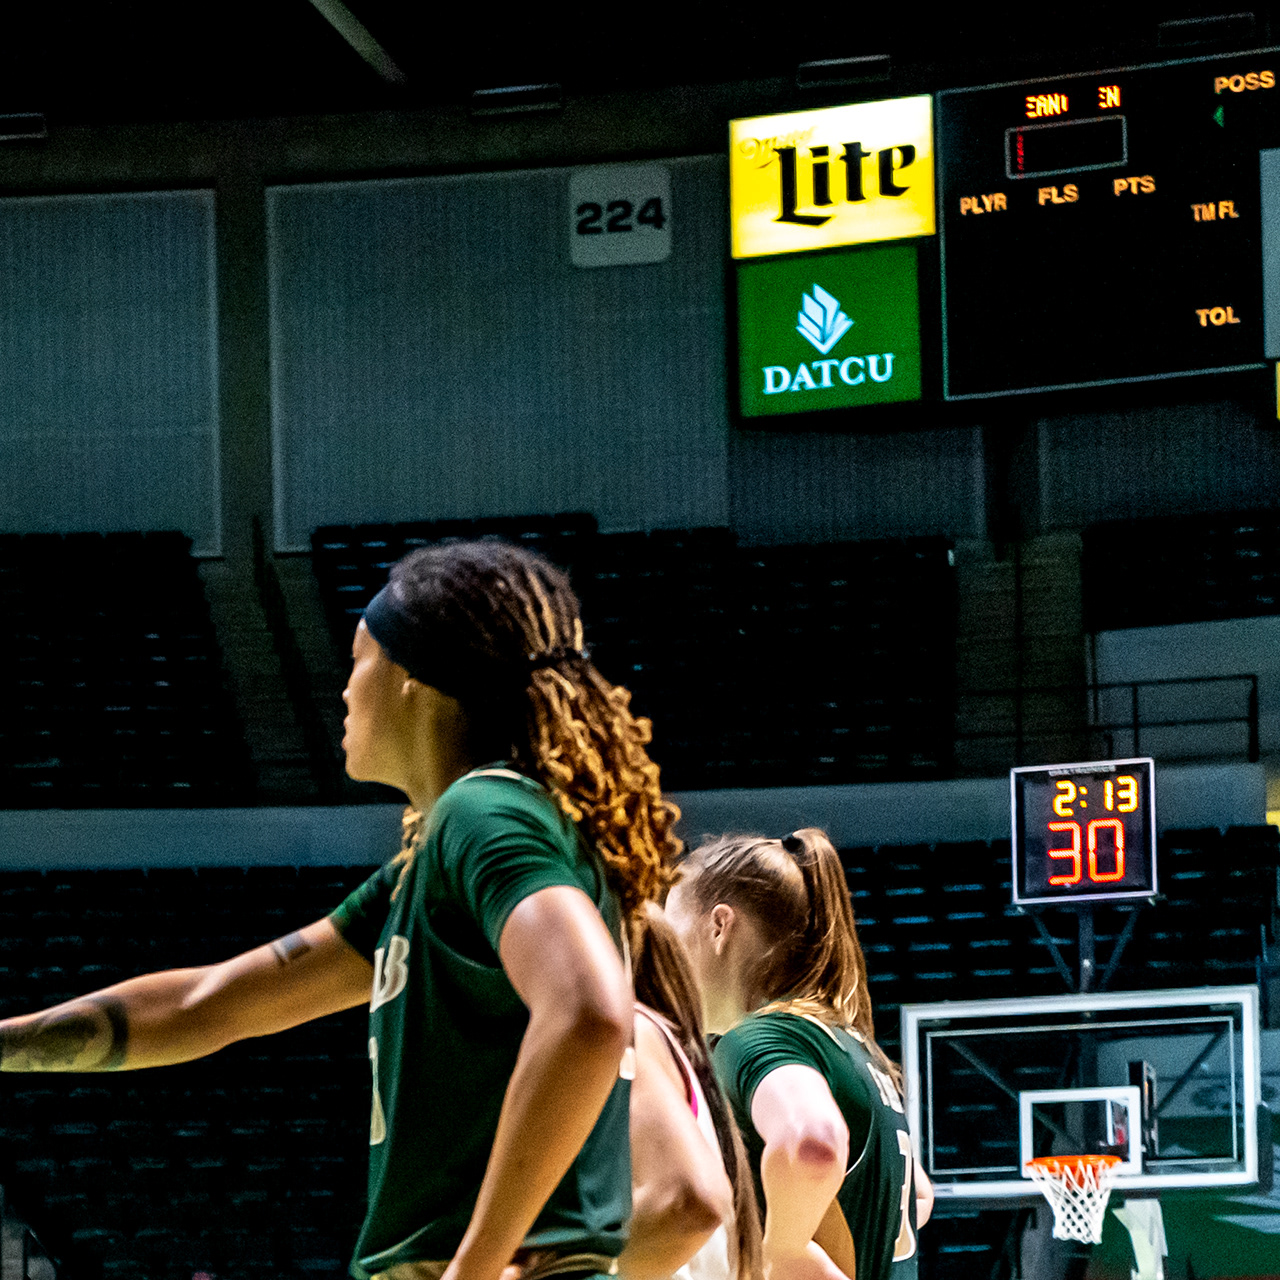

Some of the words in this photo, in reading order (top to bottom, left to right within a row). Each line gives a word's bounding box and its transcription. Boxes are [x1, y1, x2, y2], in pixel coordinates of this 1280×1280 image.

[1214, 69, 1276, 94] POSS
[772, 141, 916, 228] Lite
[959, 192, 1008, 216] PLYR
[1037, 184, 1080, 206] FLS
[1113, 175, 1157, 197] PTS
[576, 198, 667, 235] 224
[1191, 202, 1216, 222] TM
[1217, 200, 1240, 220] FL
[1195, 306, 1240, 327] TOL
[762, 352, 896, 395] DATCU
[1052, 775, 1139, 818] 2:13
[1047, 817, 1126, 886] 30
